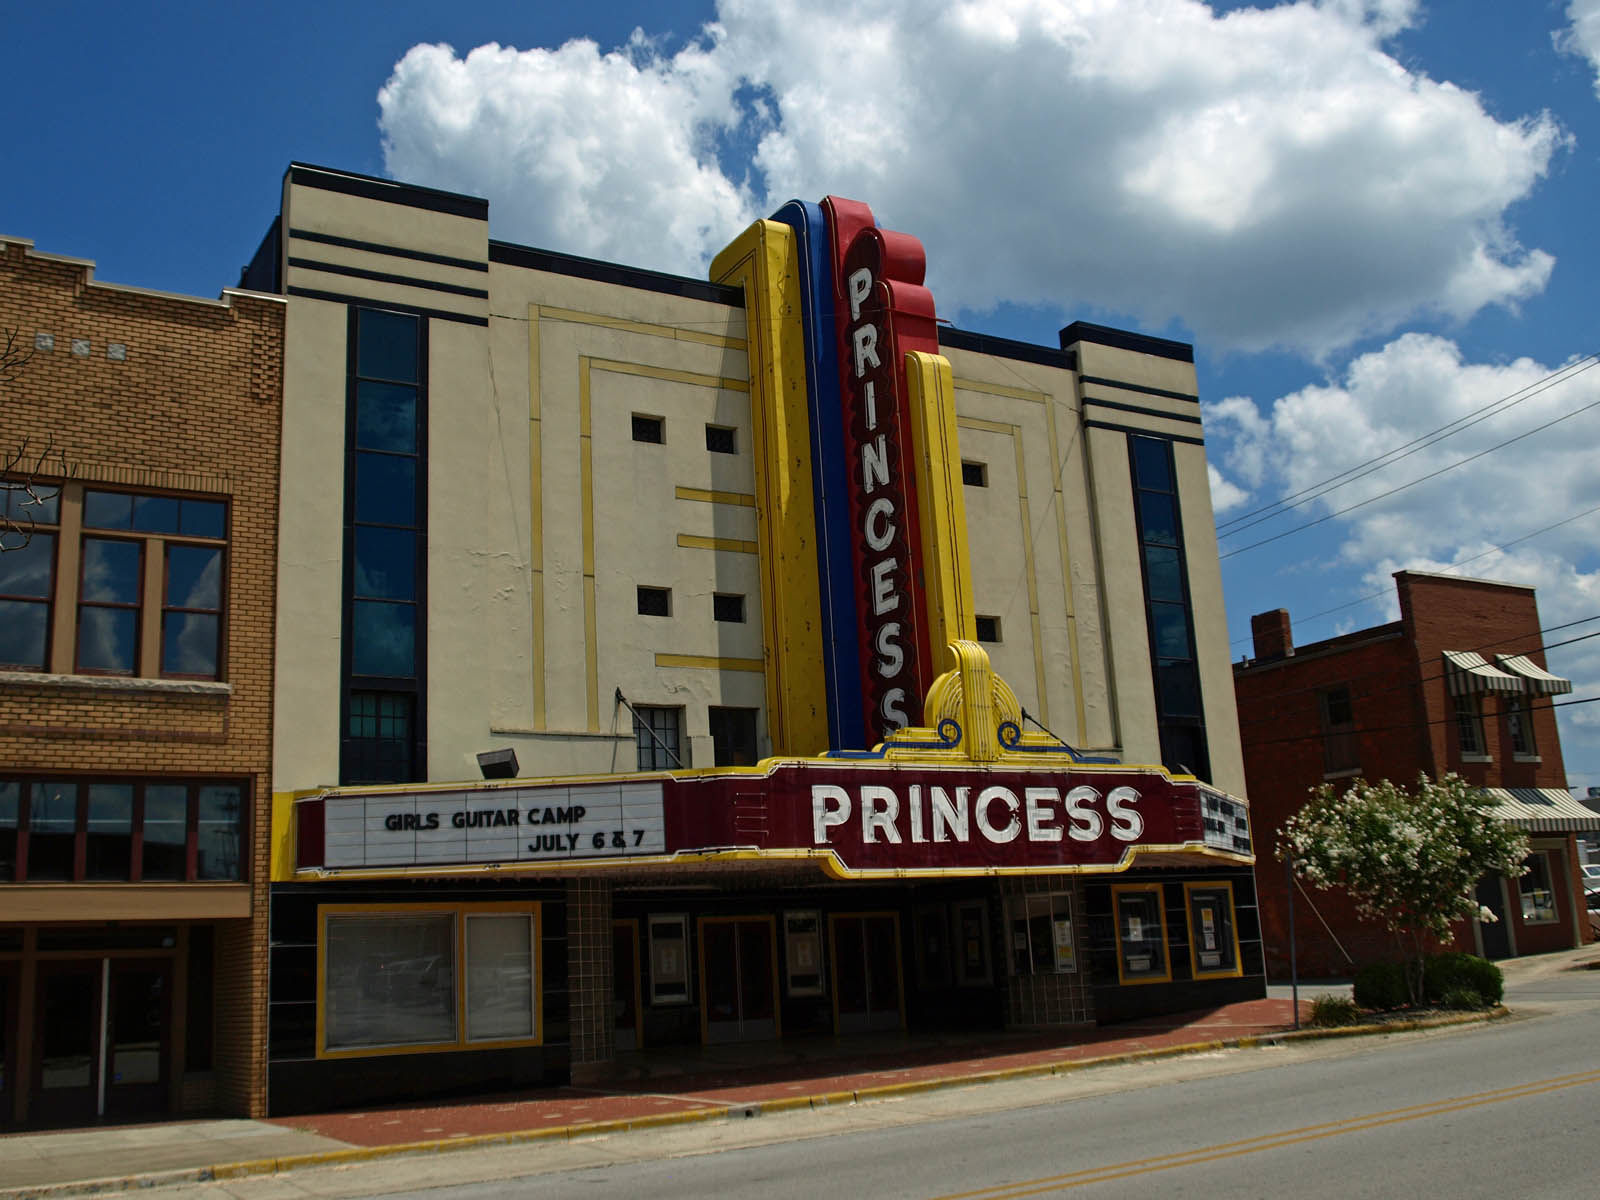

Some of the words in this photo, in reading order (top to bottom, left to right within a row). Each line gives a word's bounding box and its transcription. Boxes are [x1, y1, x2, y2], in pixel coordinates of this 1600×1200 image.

[848, 266, 909, 737] PRINCESS
[385, 812, 440, 831] GIRLS
[451, 808, 520, 829] GUITAR
[527, 805, 586, 826] CAMP
[811, 784, 1145, 847] PRINCESS
[528, 832, 580, 852] JULY
[591, 832, 606, 850] 6
[632, 828, 646, 848] 7
